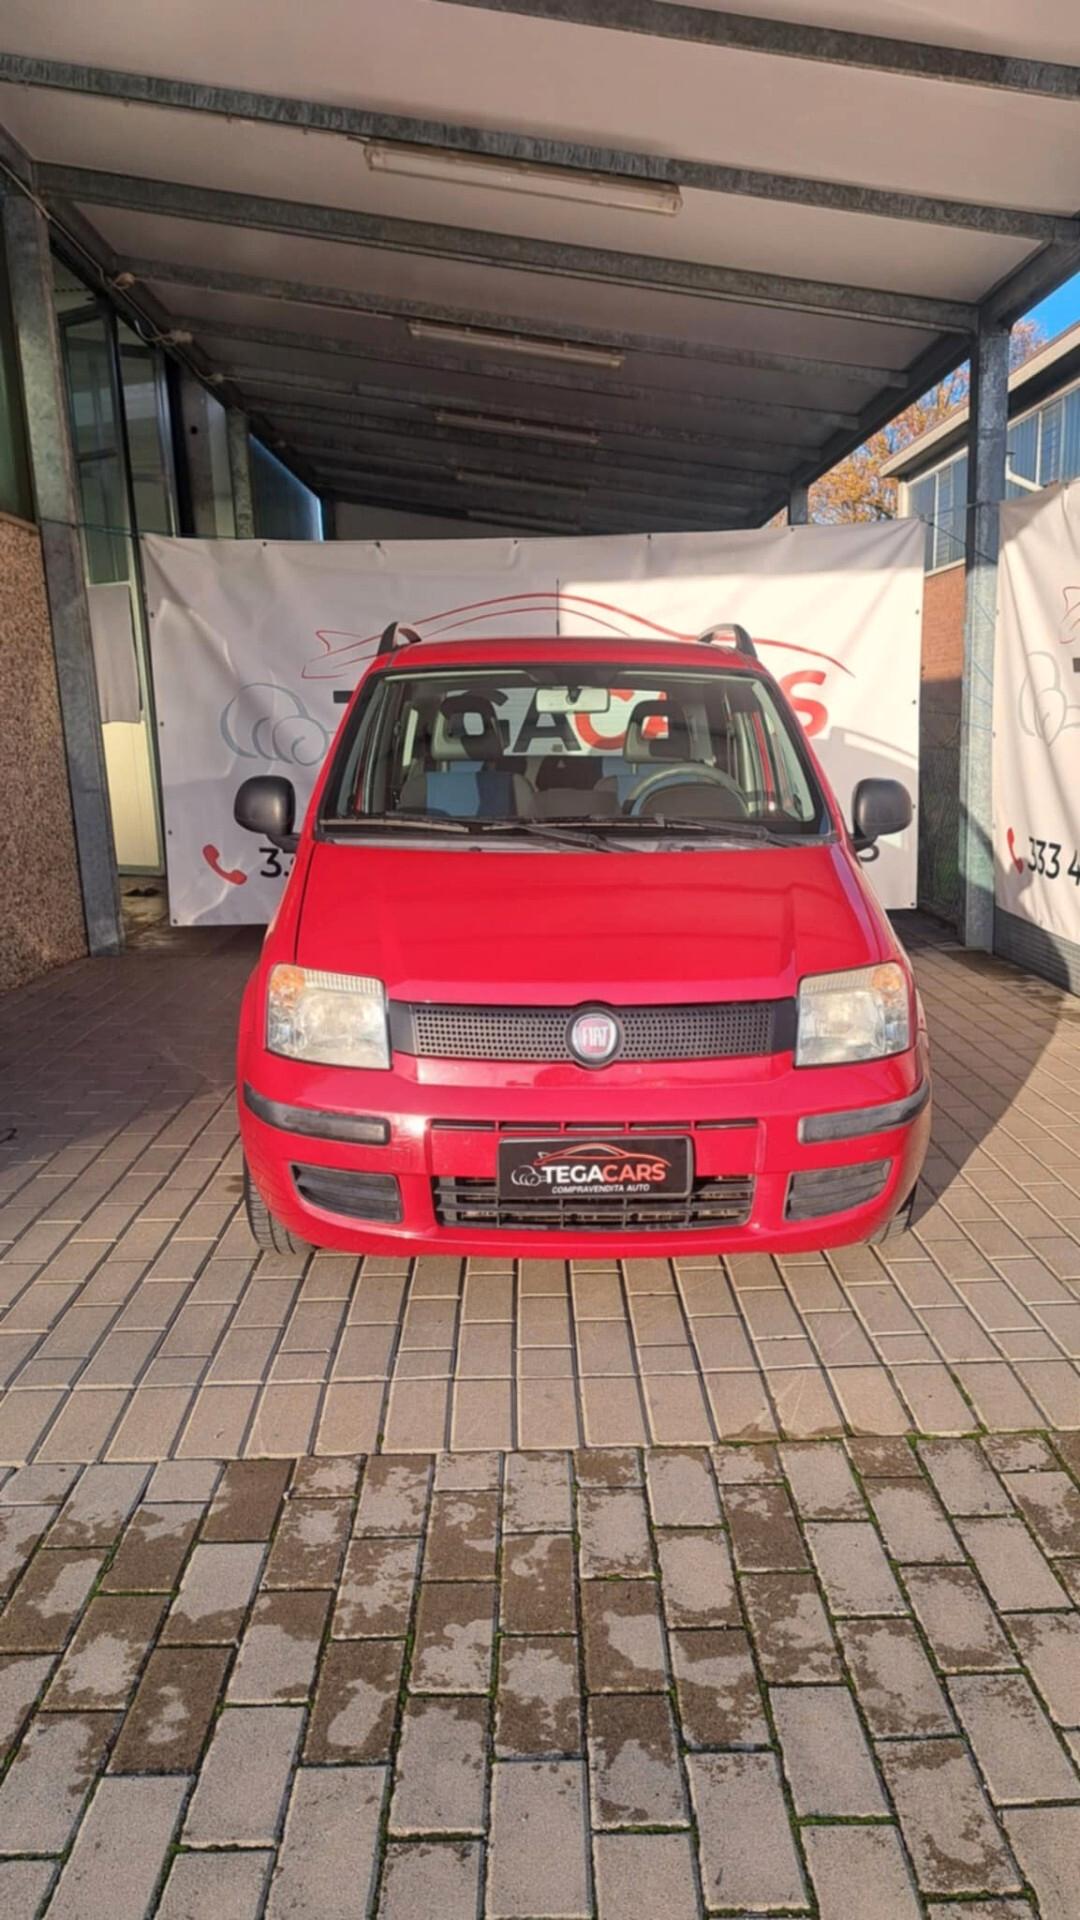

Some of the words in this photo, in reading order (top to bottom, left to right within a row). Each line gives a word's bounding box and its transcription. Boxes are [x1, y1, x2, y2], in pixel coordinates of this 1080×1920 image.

[1028, 836, 1061, 879] 333
[582, 1026, 609, 1048] FIAT
[541, 1163, 666, 1183] TEGACARS
[552, 1185, 624, 1194] COMPRAVENDITA
[626, 1184, 650, 1192] AUTO
